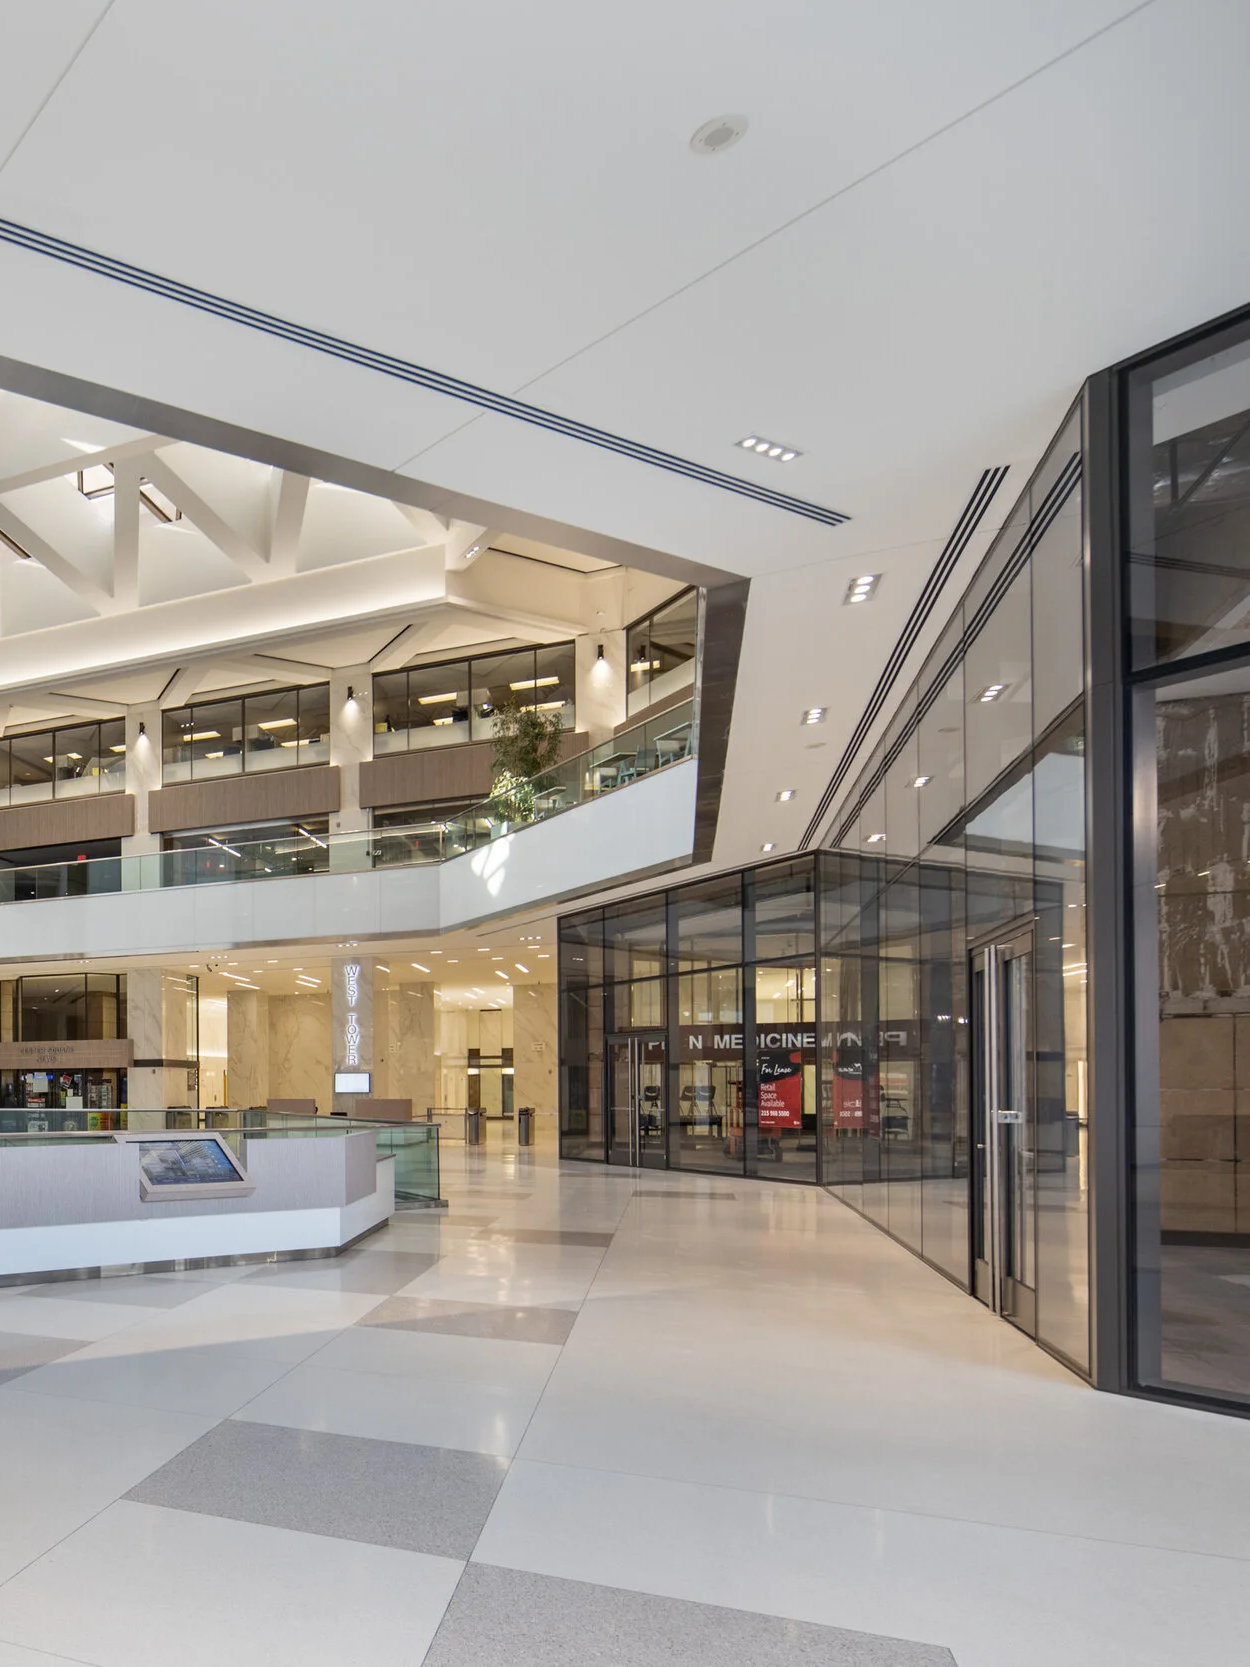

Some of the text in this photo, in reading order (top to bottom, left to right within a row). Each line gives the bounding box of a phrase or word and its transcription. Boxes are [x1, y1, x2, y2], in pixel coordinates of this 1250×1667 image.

[345, 966, 359, 1065] WEST TOWER
[713, 1033, 816, 1049] MEICINE
[761, 1063, 792, 1076] For Lease
[760, 1083, 776, 1091] Retail
[760, 1091, 777, 1100] Space
[760, 1100, 785, 1108] Available
